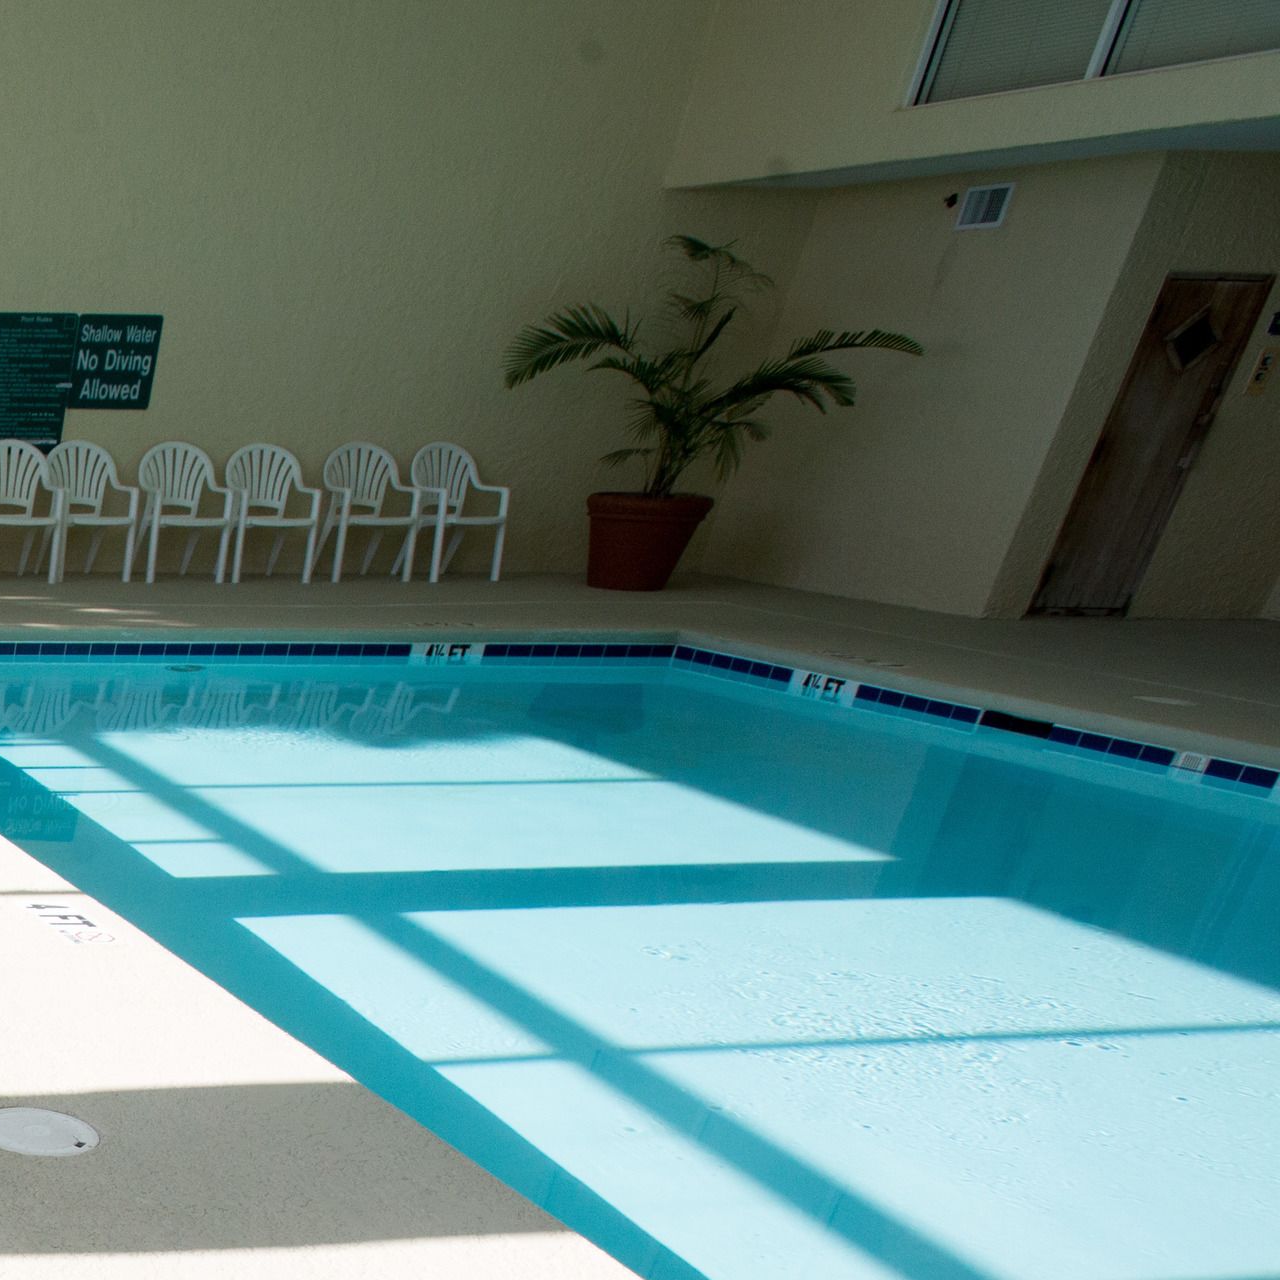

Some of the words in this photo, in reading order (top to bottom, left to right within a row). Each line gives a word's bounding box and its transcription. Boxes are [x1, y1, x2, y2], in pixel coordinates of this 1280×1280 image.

[81, 324, 122, 342] Shallow
[126, 325, 157, 343] Water
[76, 349, 98, 371] No
[104, 349, 152, 376] Diving
[79, 378, 141, 400] Allowed
